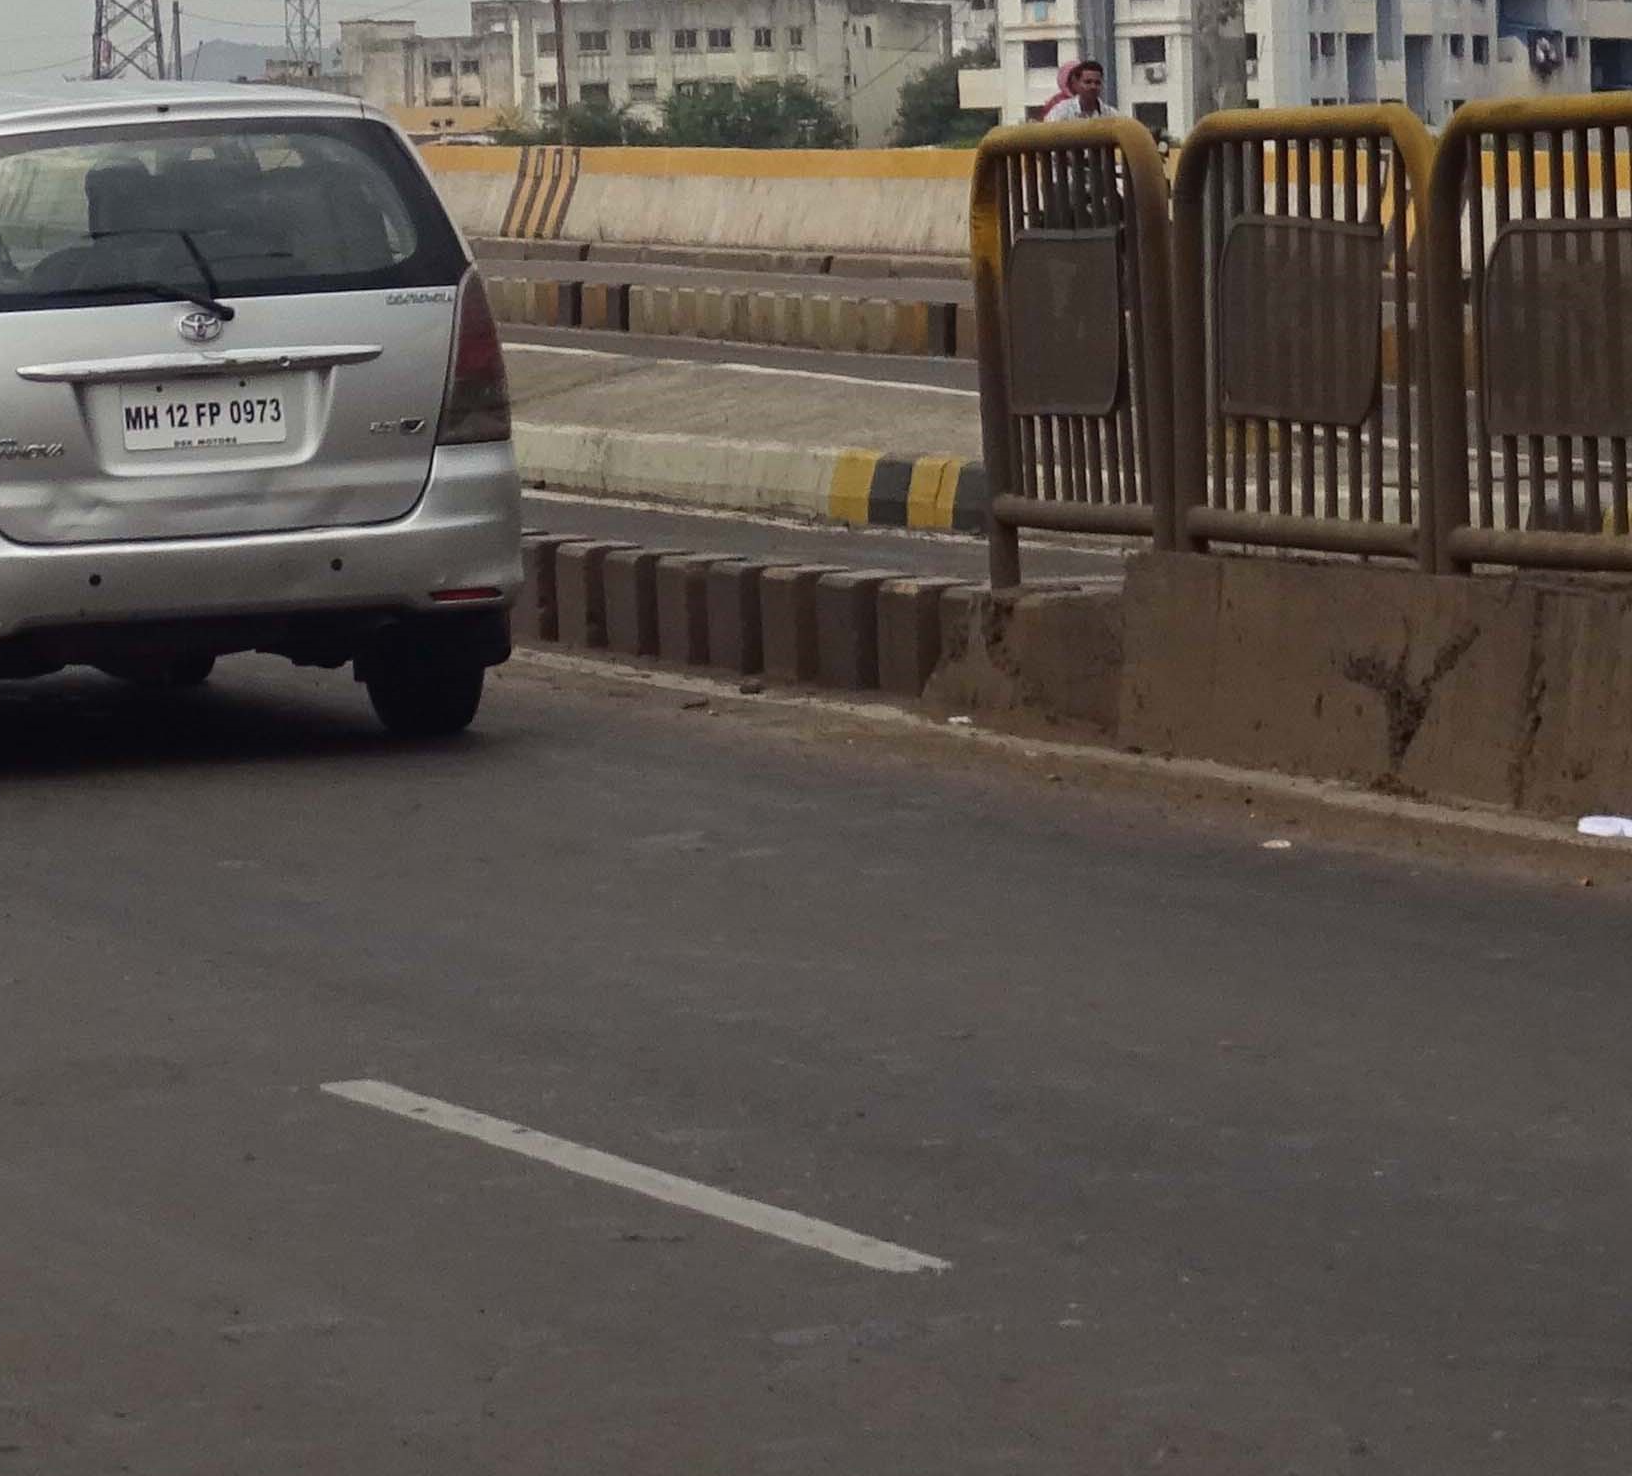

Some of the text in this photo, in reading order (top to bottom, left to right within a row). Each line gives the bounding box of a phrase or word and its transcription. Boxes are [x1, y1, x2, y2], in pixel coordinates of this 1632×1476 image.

[124, 398, 282, 431] MH 12 FP 0973
